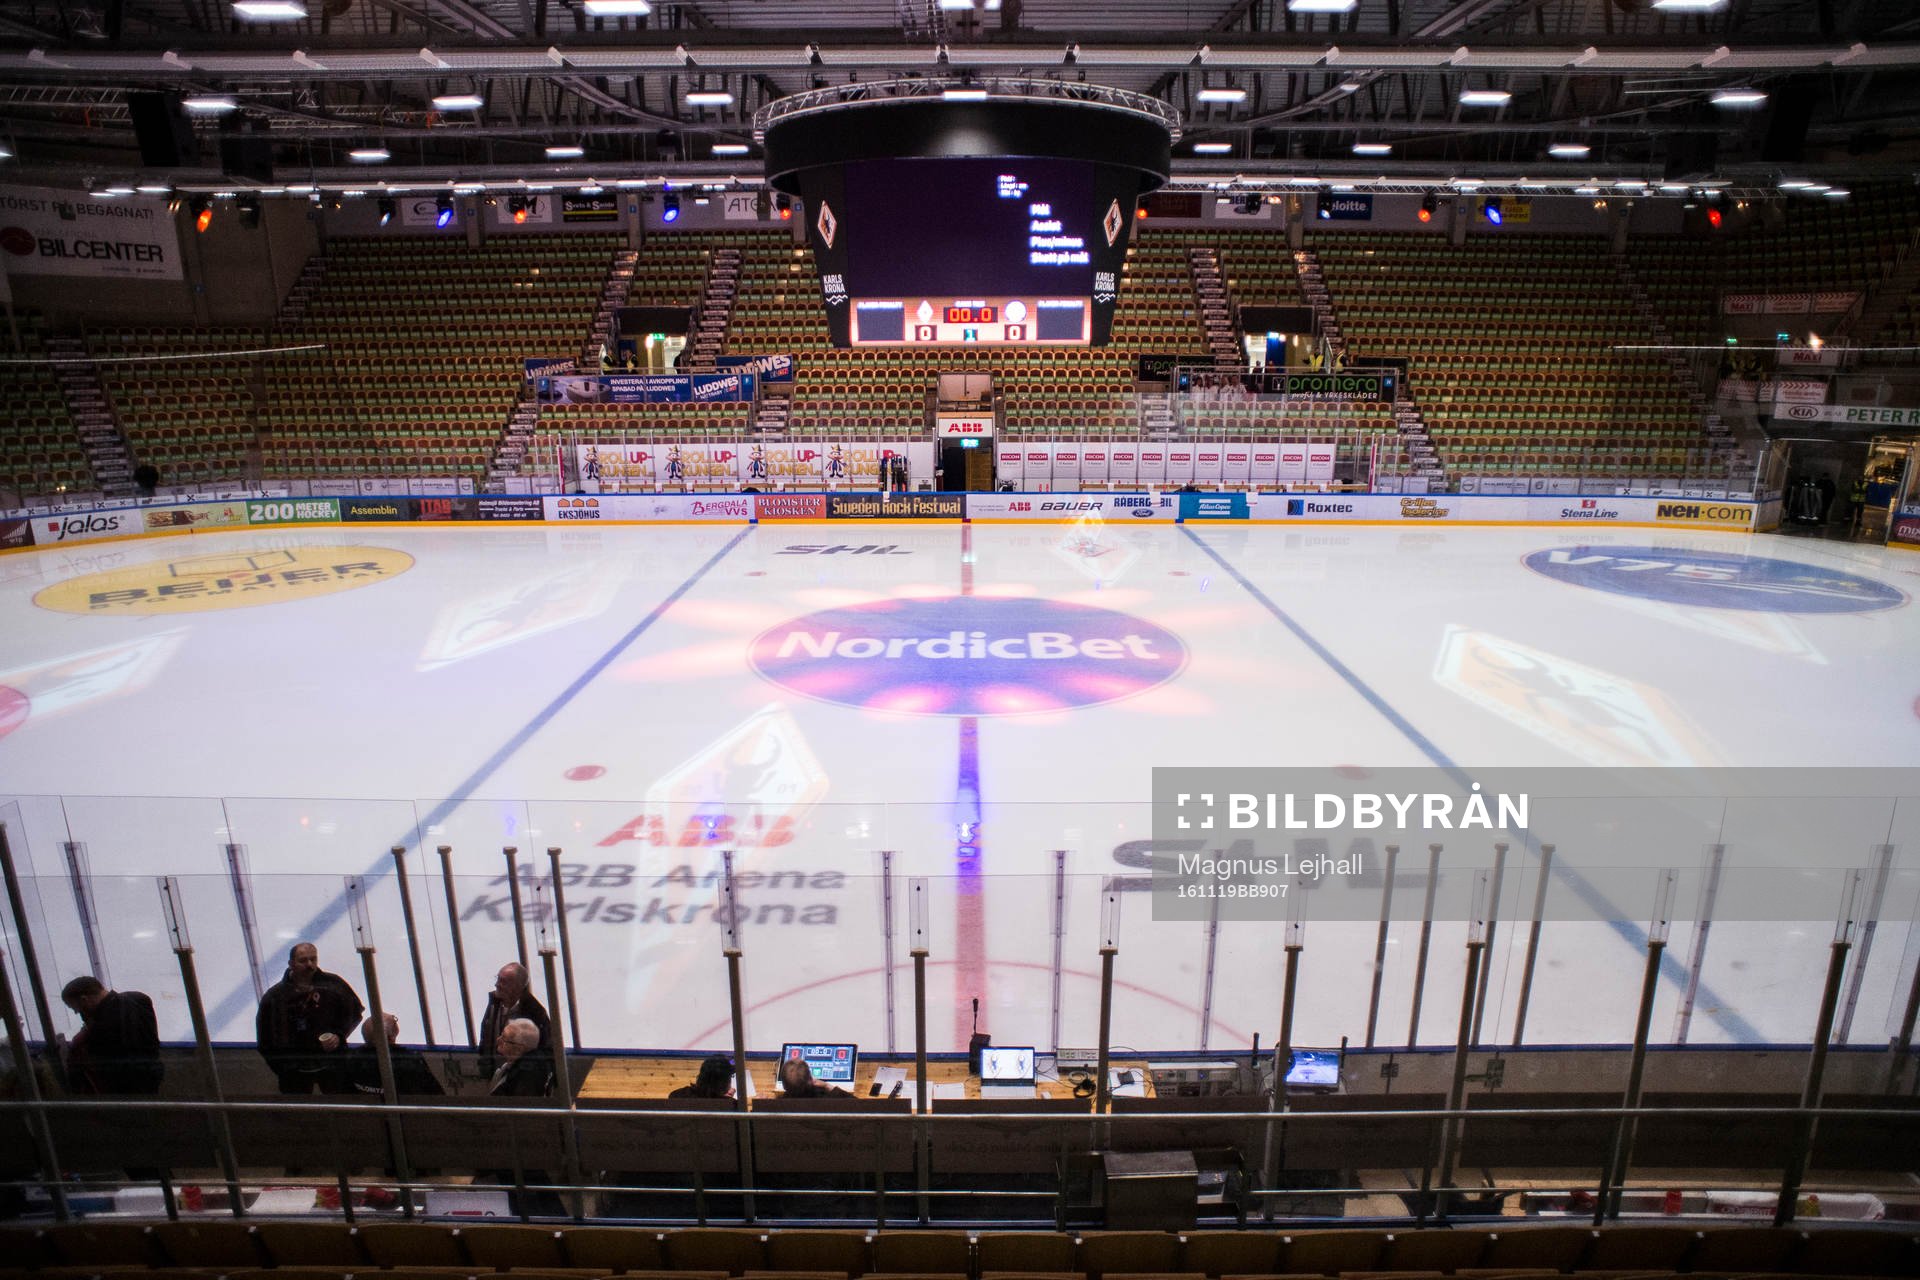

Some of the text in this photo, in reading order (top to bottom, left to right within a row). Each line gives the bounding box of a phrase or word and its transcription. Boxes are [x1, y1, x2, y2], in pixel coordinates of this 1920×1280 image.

[38, 238, 164, 263] BILCENTER
[823, 274, 843, 284] KARLS
[824, 283, 846, 293] KRONA
[919, 326, 931, 340] 0
[1009, 325, 1021, 340] 0
[694, 376, 739, 396] LUDDWES
[1288, 377, 1378, 394] promera
[1792, 407, 1814, 417] KIA
[1846, 408, 1903, 423] PETER
[948, 422, 984, 433] ABB
[296, 502, 331, 511] METER
[690, 499, 748, 516] BERGDALA
[758, 498, 821, 507] BLOMSTER
[833, 497, 881, 515] Sweden
[882, 497, 911, 514] Rock
[913, 497, 961, 514] Festival
[1008, 502, 1031, 511] ABB
[1307, 503, 1353, 513] Roxtec
[250, 502, 294, 521] 200
[296, 509, 337, 519] HOCKEY
[350, 505, 398, 515] Assemblin
[558, 508, 600, 519] EKSJÖHUS
[725, 508, 748, 516] VVS
[764, 507, 816, 516] KIOSKEN
[1561, 509, 1618, 519] Stena Line
[57, 514, 120, 540] jalas
[773, 544, 913, 555] SHL
[1548, 550, 1742, 582] V75
[89, 562, 384, 605] BEIJER
[776, 631, 1160, 660] NordicBet
[594, 815, 796, 848] ABB
[488, 863, 846, 889] ABB Arena
[460, 895, 840, 925] Karlskrona
